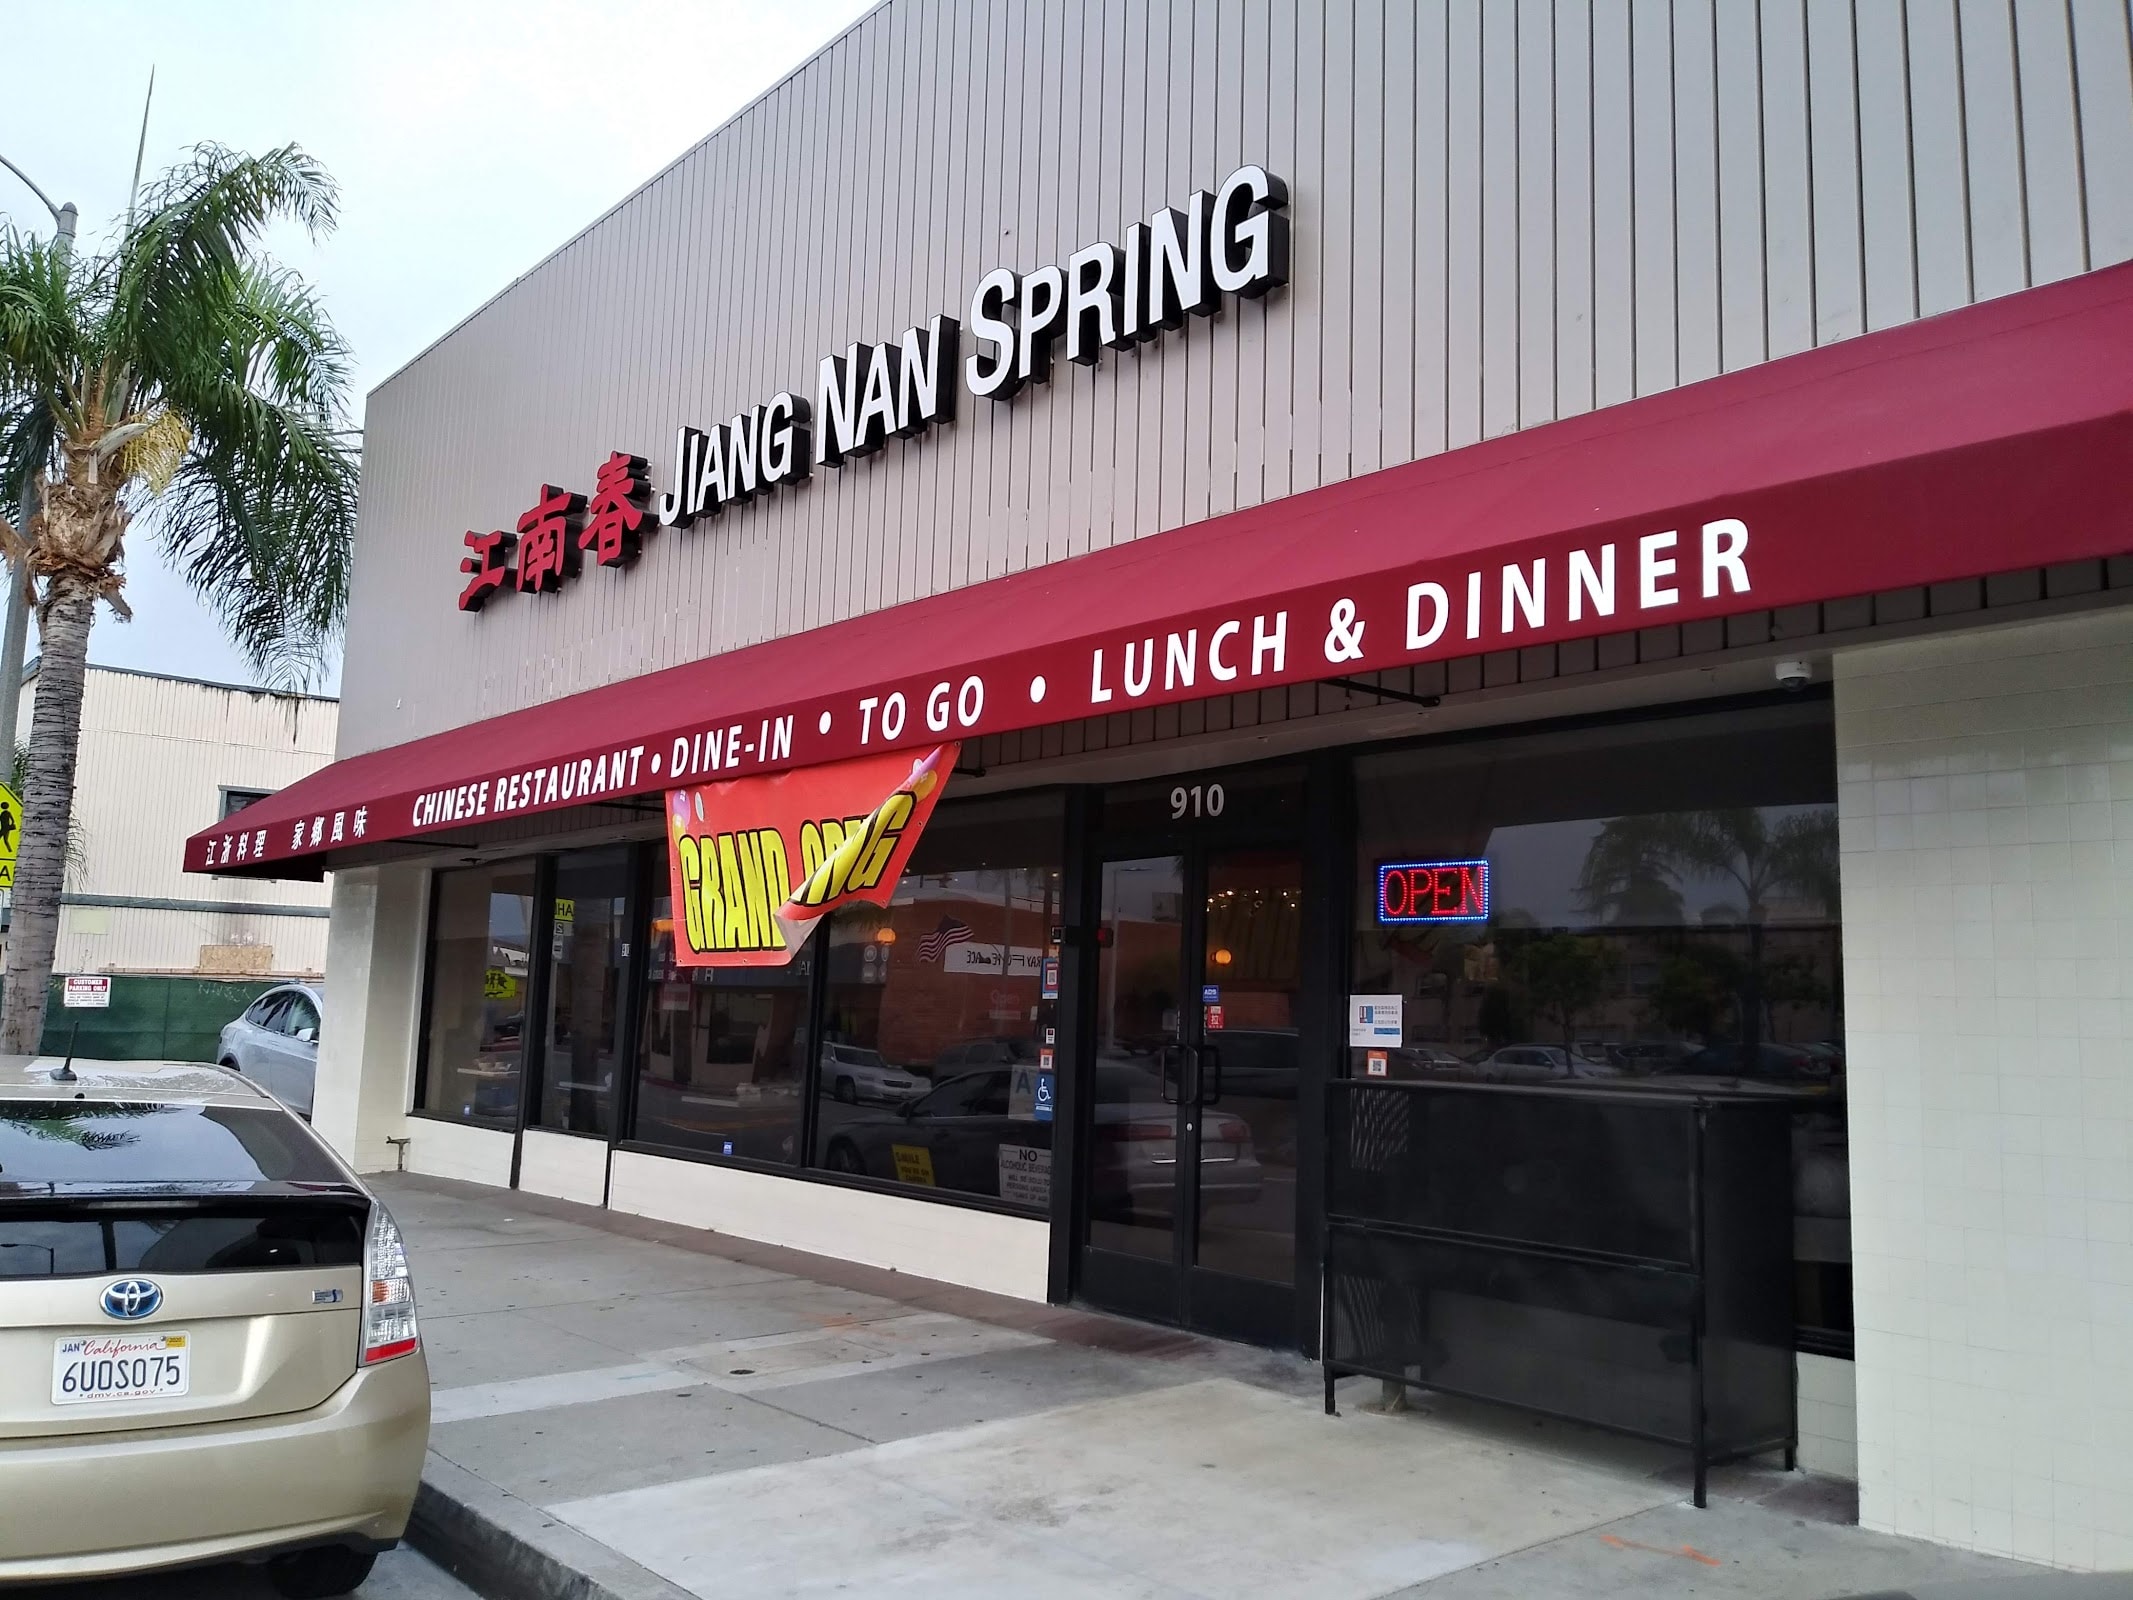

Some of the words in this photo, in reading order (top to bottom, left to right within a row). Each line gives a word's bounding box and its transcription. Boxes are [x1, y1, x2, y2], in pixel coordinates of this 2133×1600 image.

[659, 392, 795, 526] JIANG
[815, 315, 942, 465] NAN
[965, 165, 1271, 397] SPRING
[459, 451, 643, 610] 江南春
[412, 781, 490, 827] CHINESE
[493, 745, 645, 813] RESTAURANT
[670, 714, 794, 778] DINE-IN
[859, 691, 906, 745] TO
[926, 675, 985, 732] GO
[1091, 611, 1288, 704] LUNCH
[1324, 598, 1366, 663] &
[1406, 518, 1751, 650] DINNER
[1170, 783, 1225, 819] 910
[679, 829, 791, 954] GRAND
[1383, 866, 1487, 915] OPEN
[1019, 1149, 1038, 1162] NO
[62, 1343, 80, 1353] JAN
[83, 1339, 166, 1358] California
[87, 1389, 156, 1399] dmv.ca.gov
